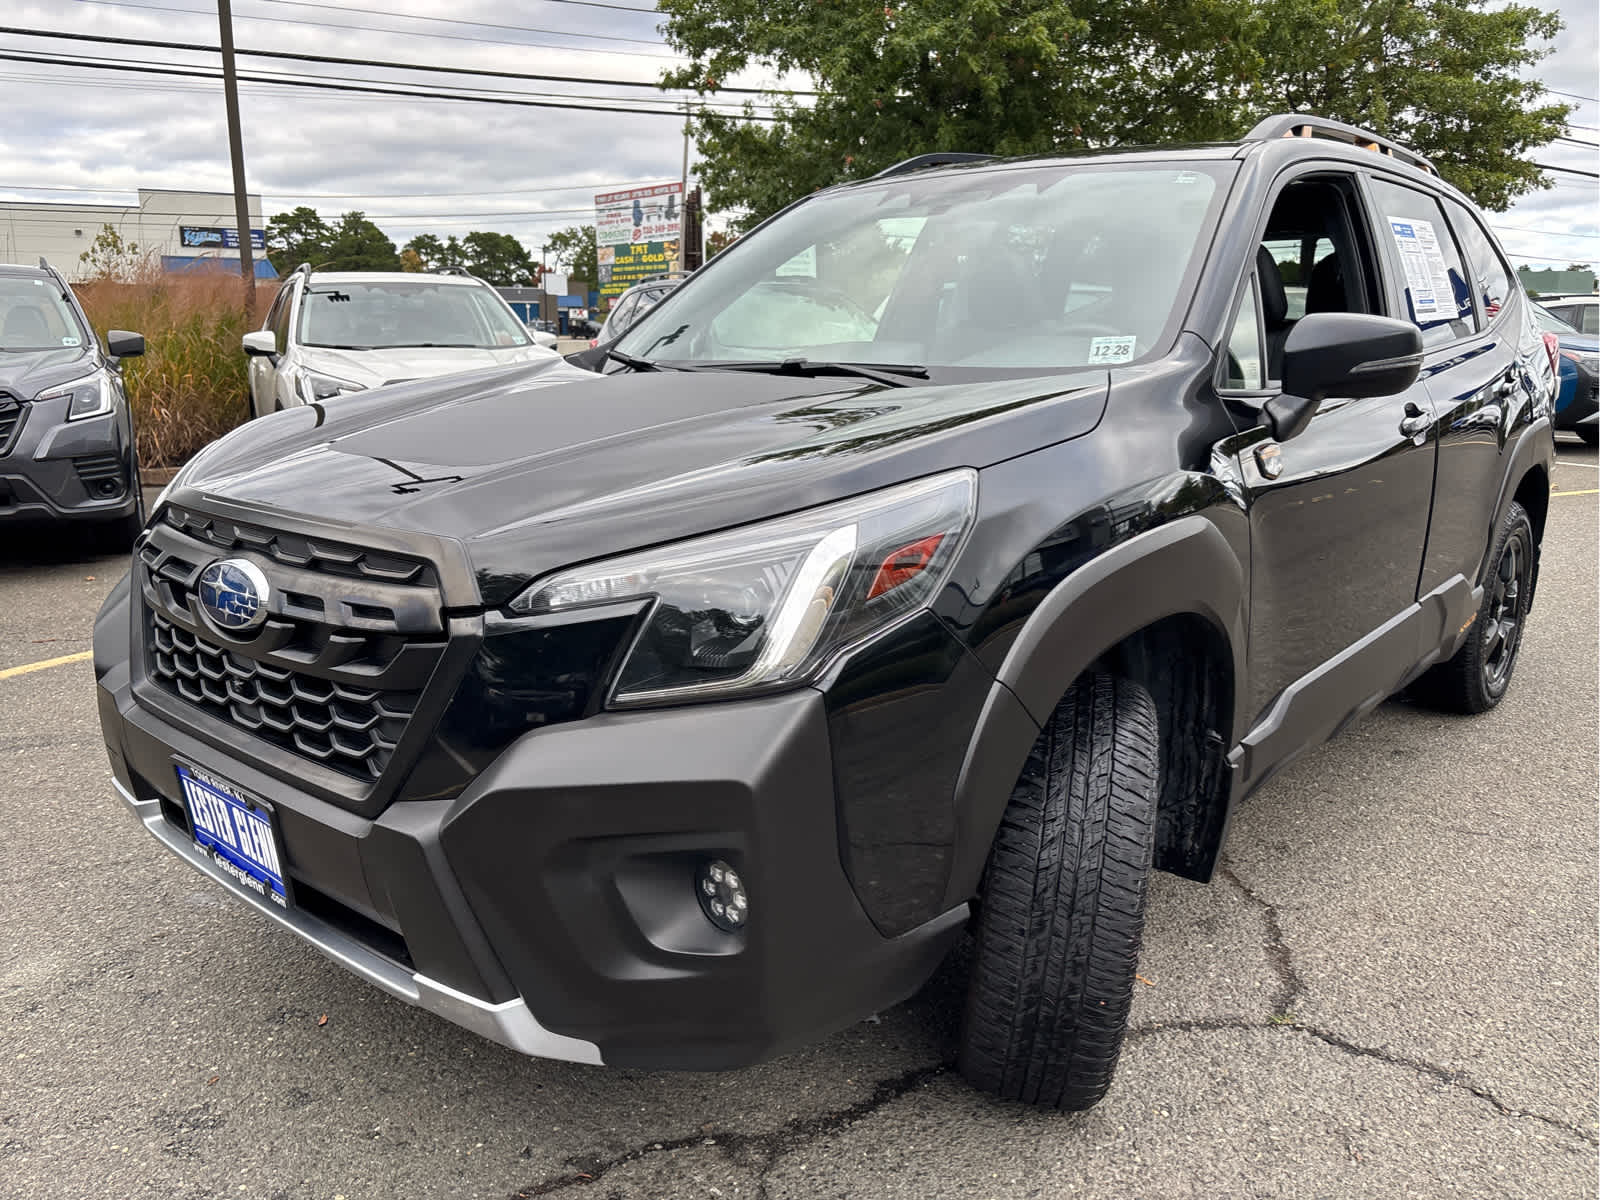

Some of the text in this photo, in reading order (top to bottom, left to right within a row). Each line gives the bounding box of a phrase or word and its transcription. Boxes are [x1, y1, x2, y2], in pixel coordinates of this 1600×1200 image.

[630, 244, 649, 255] TMT
[615, 256, 634, 264] CASH
[641, 253, 665, 263] GOLD
[1094, 344, 1130, 356] 12 28
[182, 778, 282, 879] LESTER GLENN
